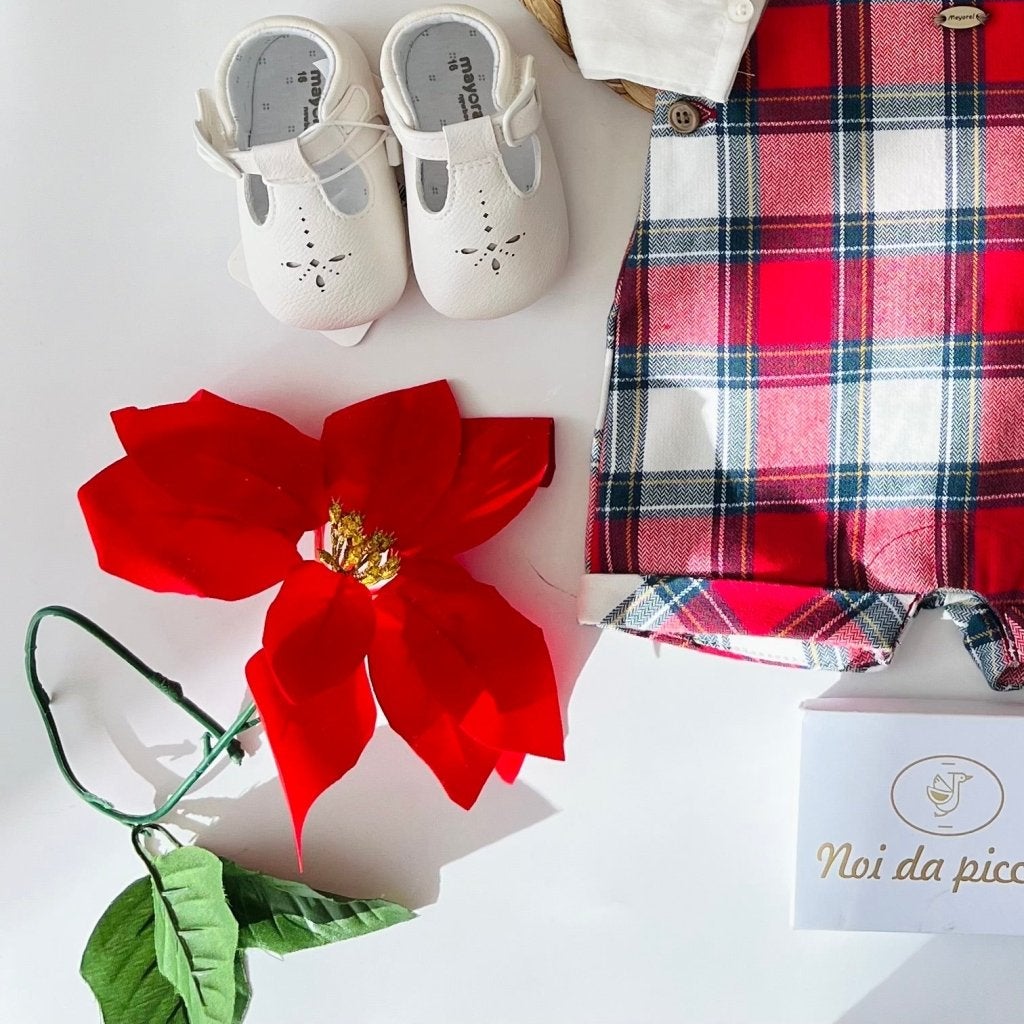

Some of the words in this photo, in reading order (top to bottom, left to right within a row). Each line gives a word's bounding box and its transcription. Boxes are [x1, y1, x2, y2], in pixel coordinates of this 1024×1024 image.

[297, 71, 308, 83] 16
[447, 59, 458, 71] 16
[459, 56, 483, 119] mayora
[816, 842, 887, 880] Noi
[891, 844, 945, 881] da
